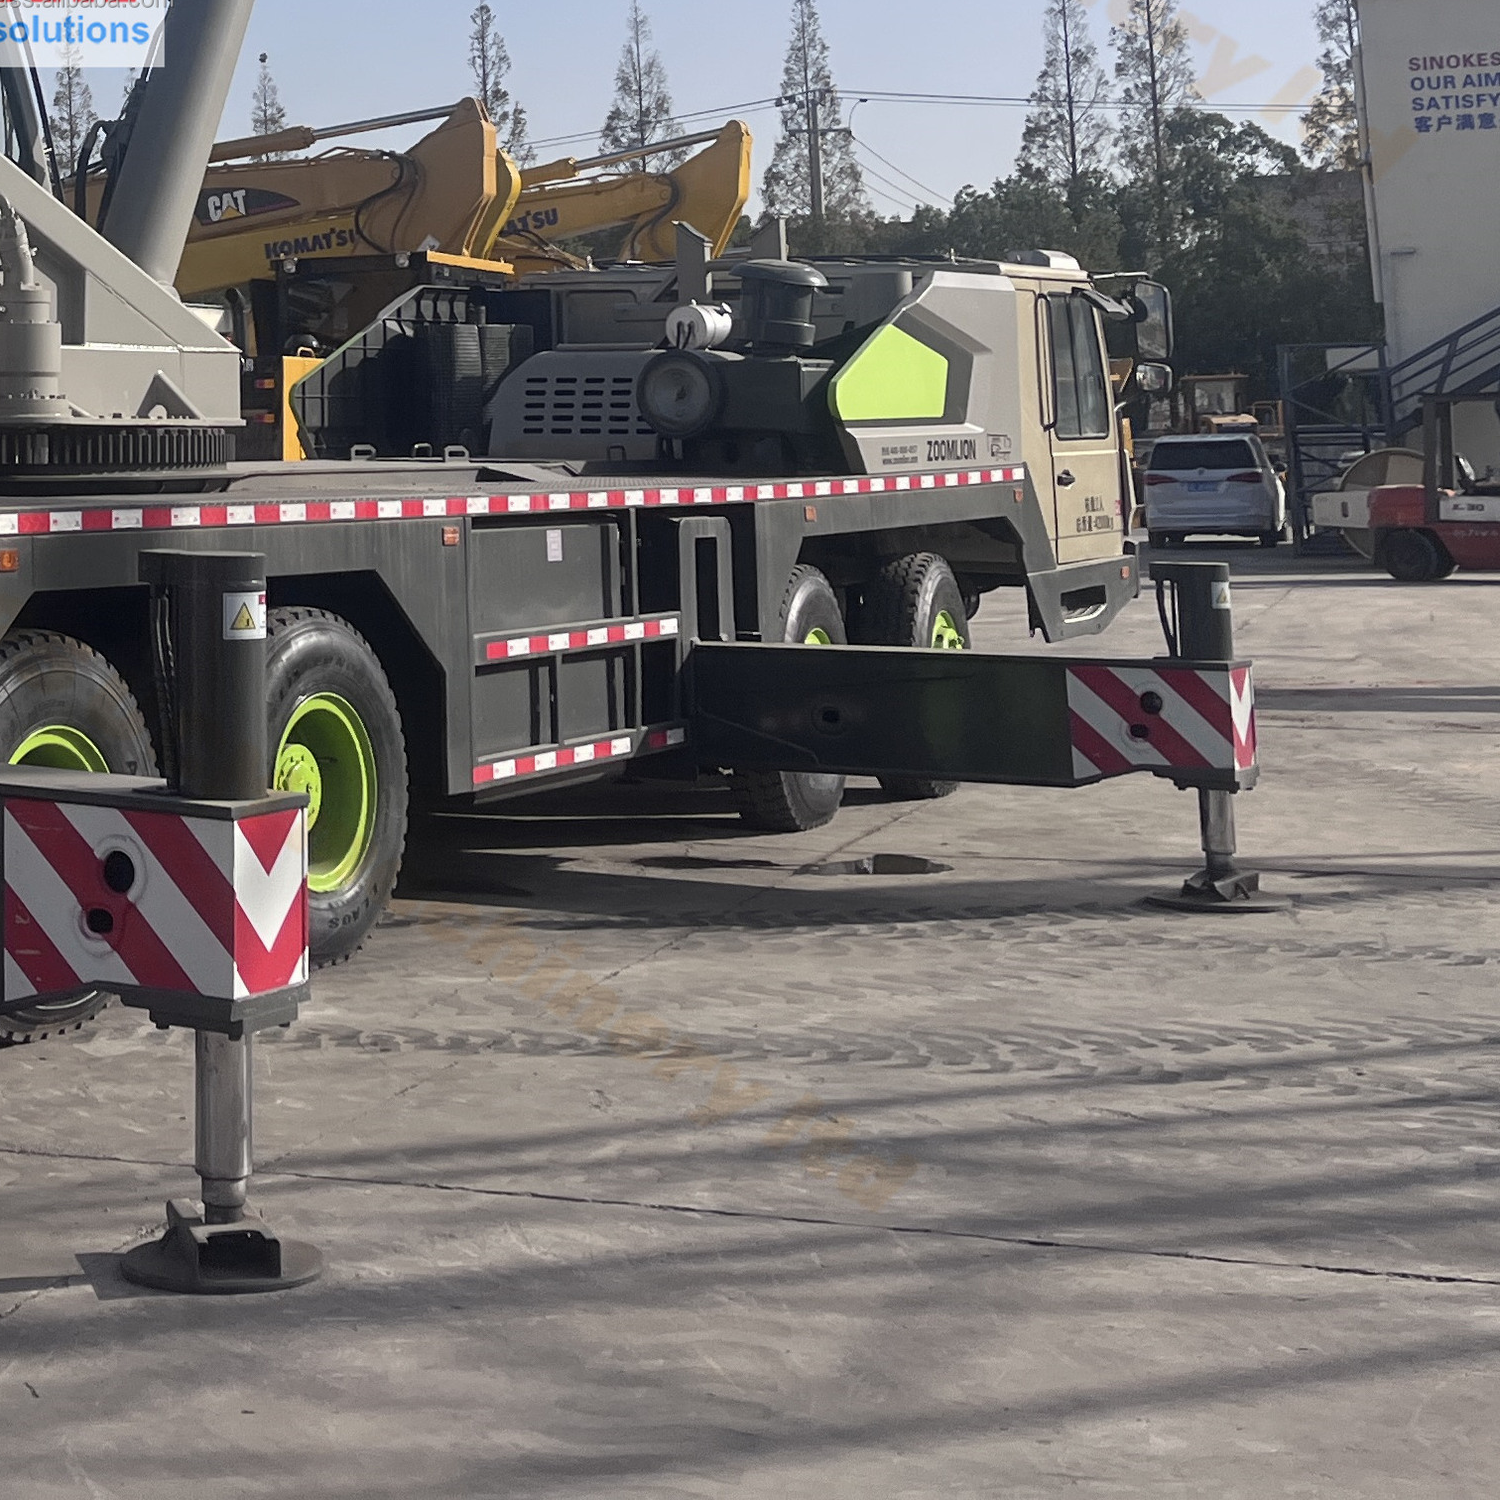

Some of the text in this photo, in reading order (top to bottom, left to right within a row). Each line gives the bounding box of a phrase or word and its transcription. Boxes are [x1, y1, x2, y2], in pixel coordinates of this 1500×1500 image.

[1410, 74, 1456, 91] OUR
[1412, 93, 1500, 111] SATISFY
[207, 189, 246, 221] CAT
[926, 439, 977, 462] ZOOMLION
